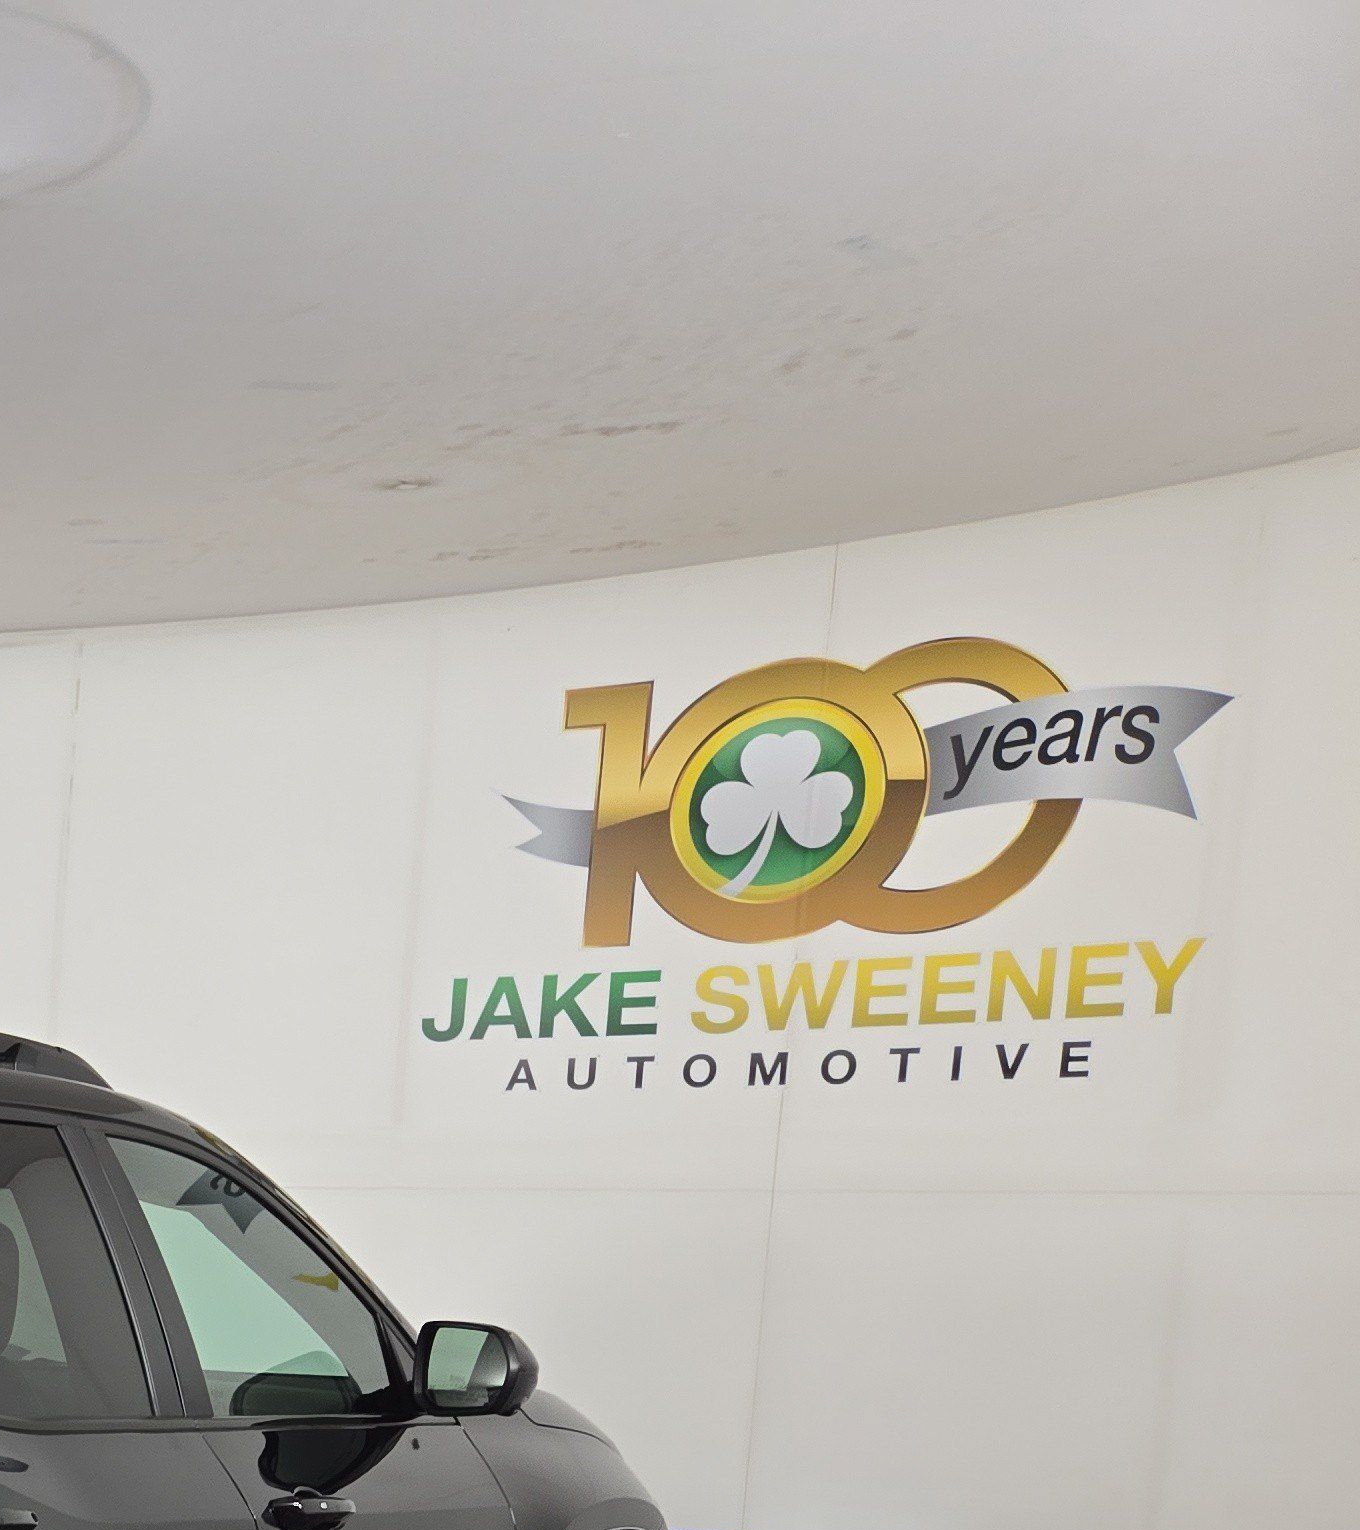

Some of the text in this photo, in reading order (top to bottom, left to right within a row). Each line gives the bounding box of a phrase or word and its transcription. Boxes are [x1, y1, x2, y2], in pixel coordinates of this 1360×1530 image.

[943, 700, 1162, 800] years
[421, 936, 1207, 1043] JAKE SWEENEY
[506, 1040, 1093, 1092] AUTOMOTIVE
